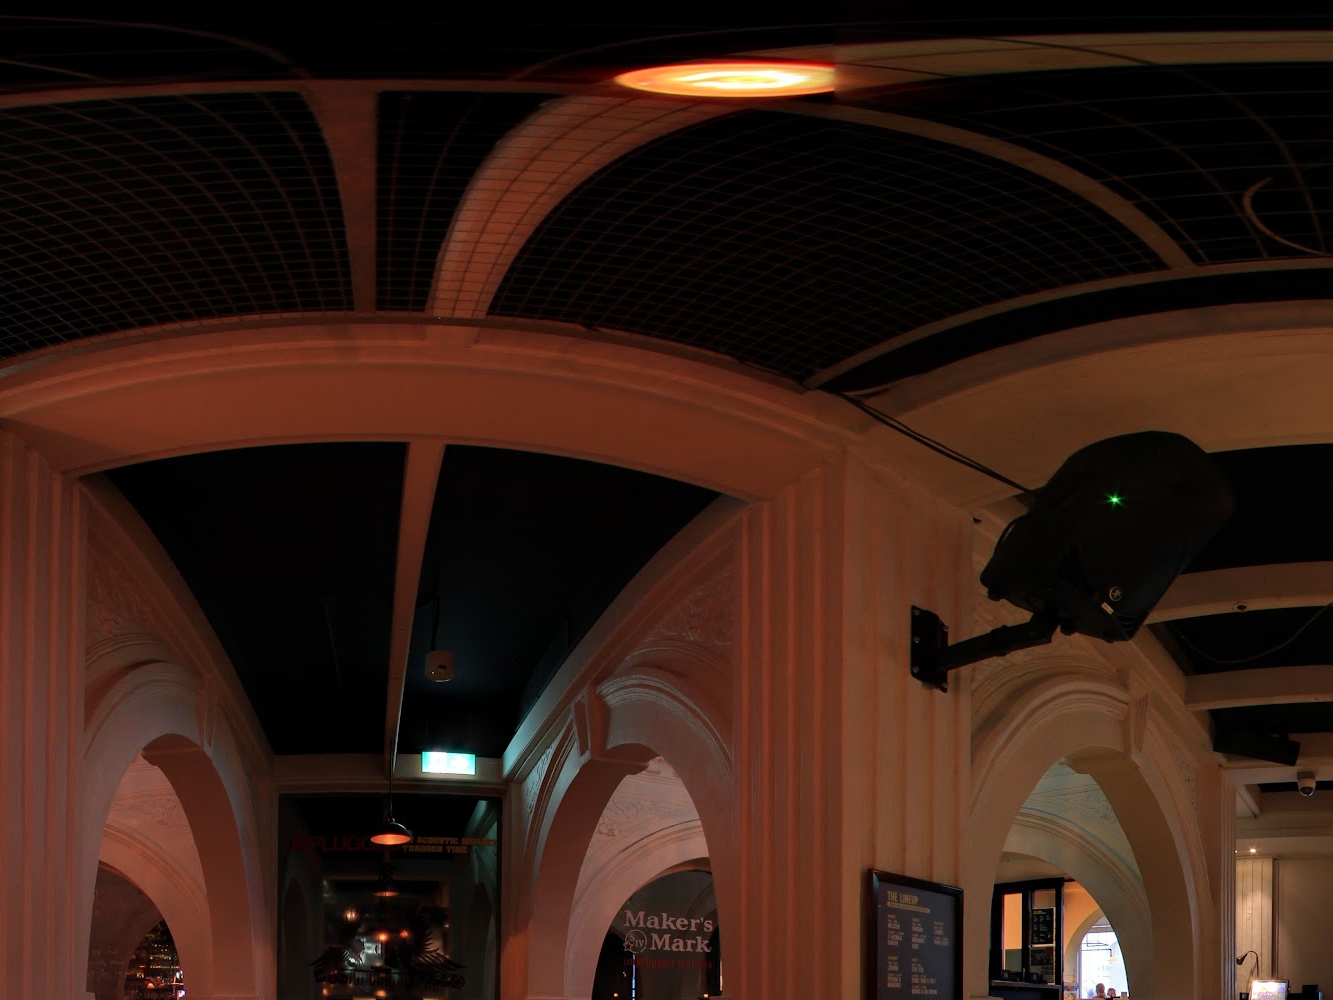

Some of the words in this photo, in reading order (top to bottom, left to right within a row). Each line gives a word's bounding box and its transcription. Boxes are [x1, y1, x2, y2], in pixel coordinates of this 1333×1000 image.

[887, 890, 899, 902] THE
[624, 910, 713, 932] Maker's
[649, 933, 712, 953] Mark
